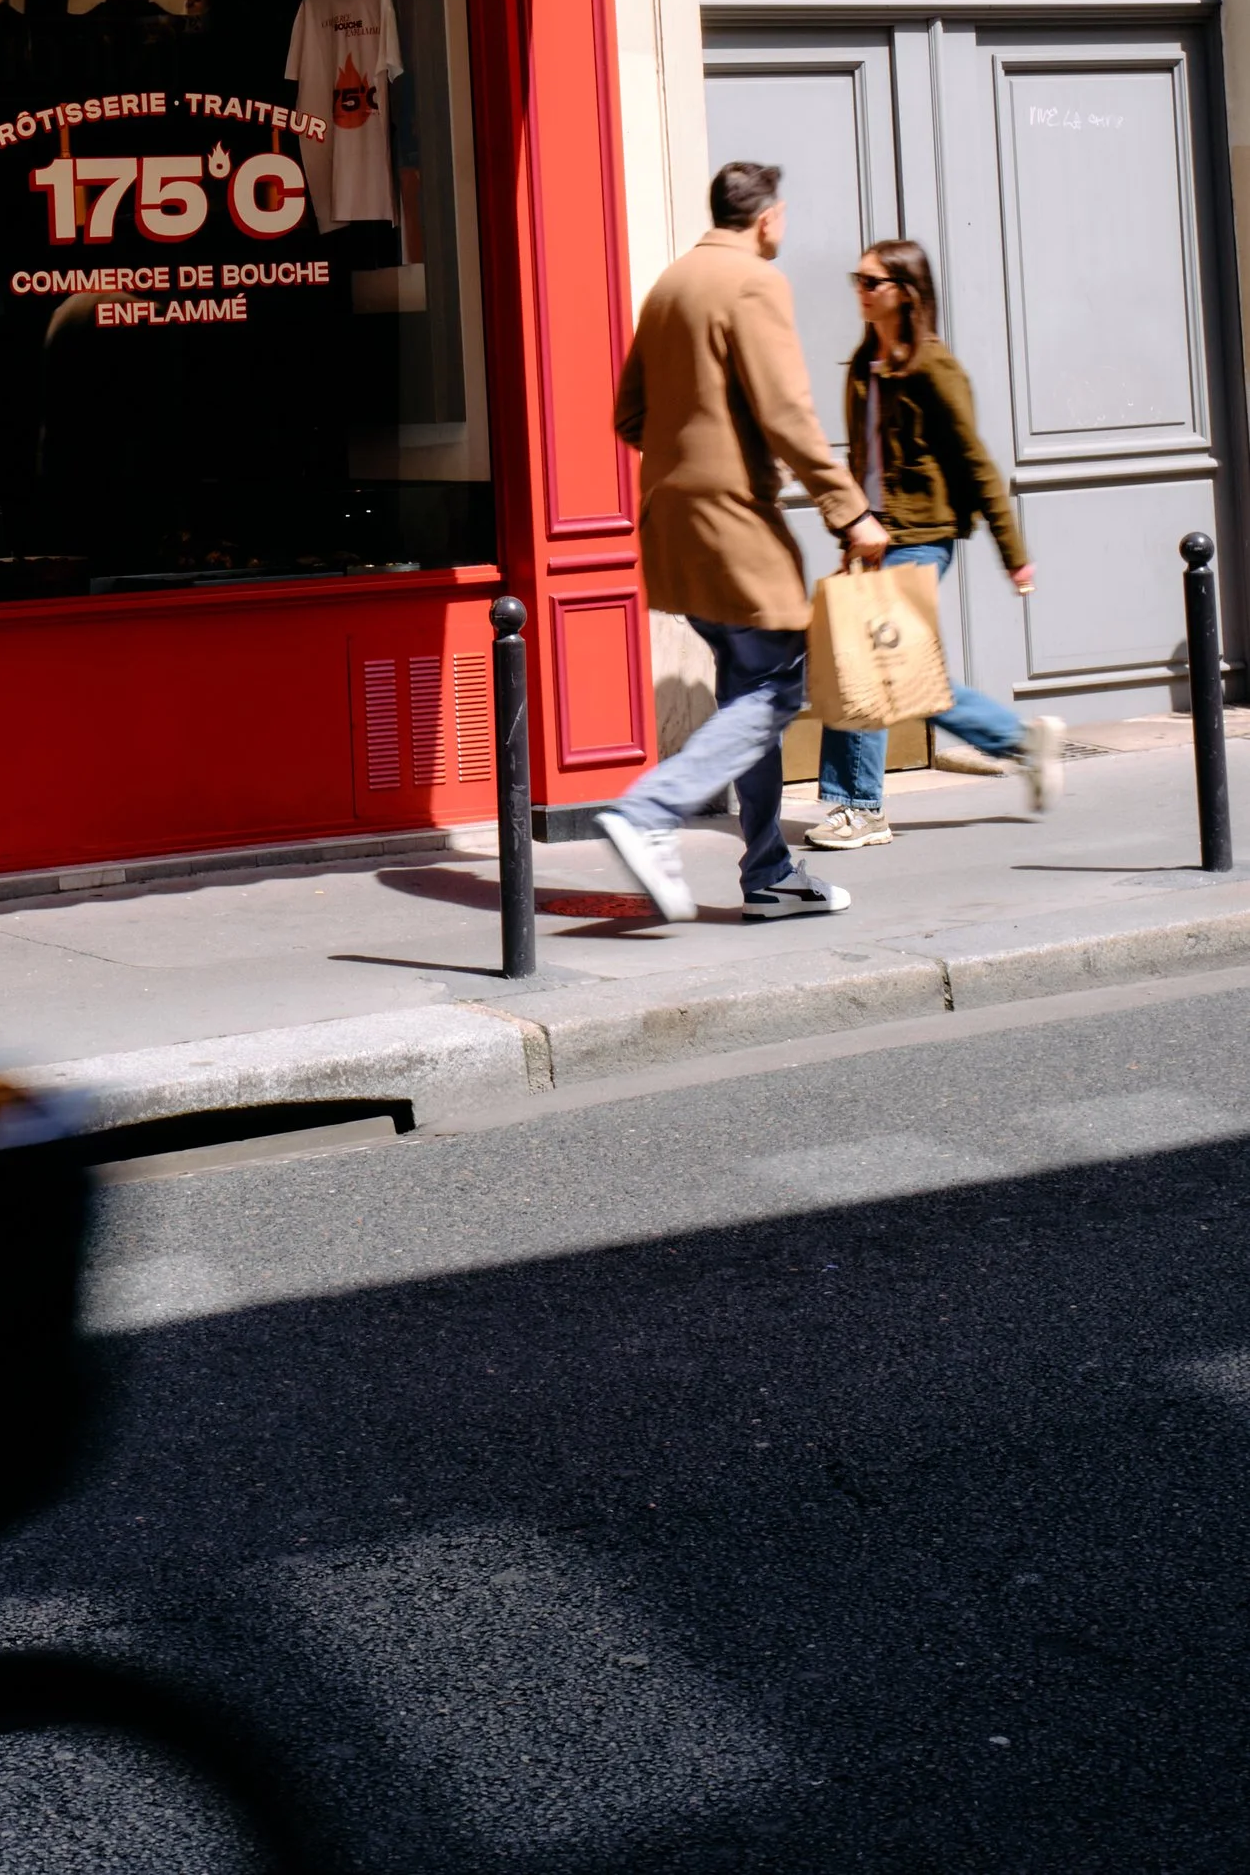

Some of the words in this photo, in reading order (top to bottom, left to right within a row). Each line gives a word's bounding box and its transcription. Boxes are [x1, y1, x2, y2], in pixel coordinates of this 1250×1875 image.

[184, 92, 328, 143] TRAITEUR
[10, 264, 171, 294] COMMERCE
[177, 264, 215, 289] DE
[221, 260, 330, 287] BOUCHE
[95, 293, 248, 328] ENFLAMMÉ
